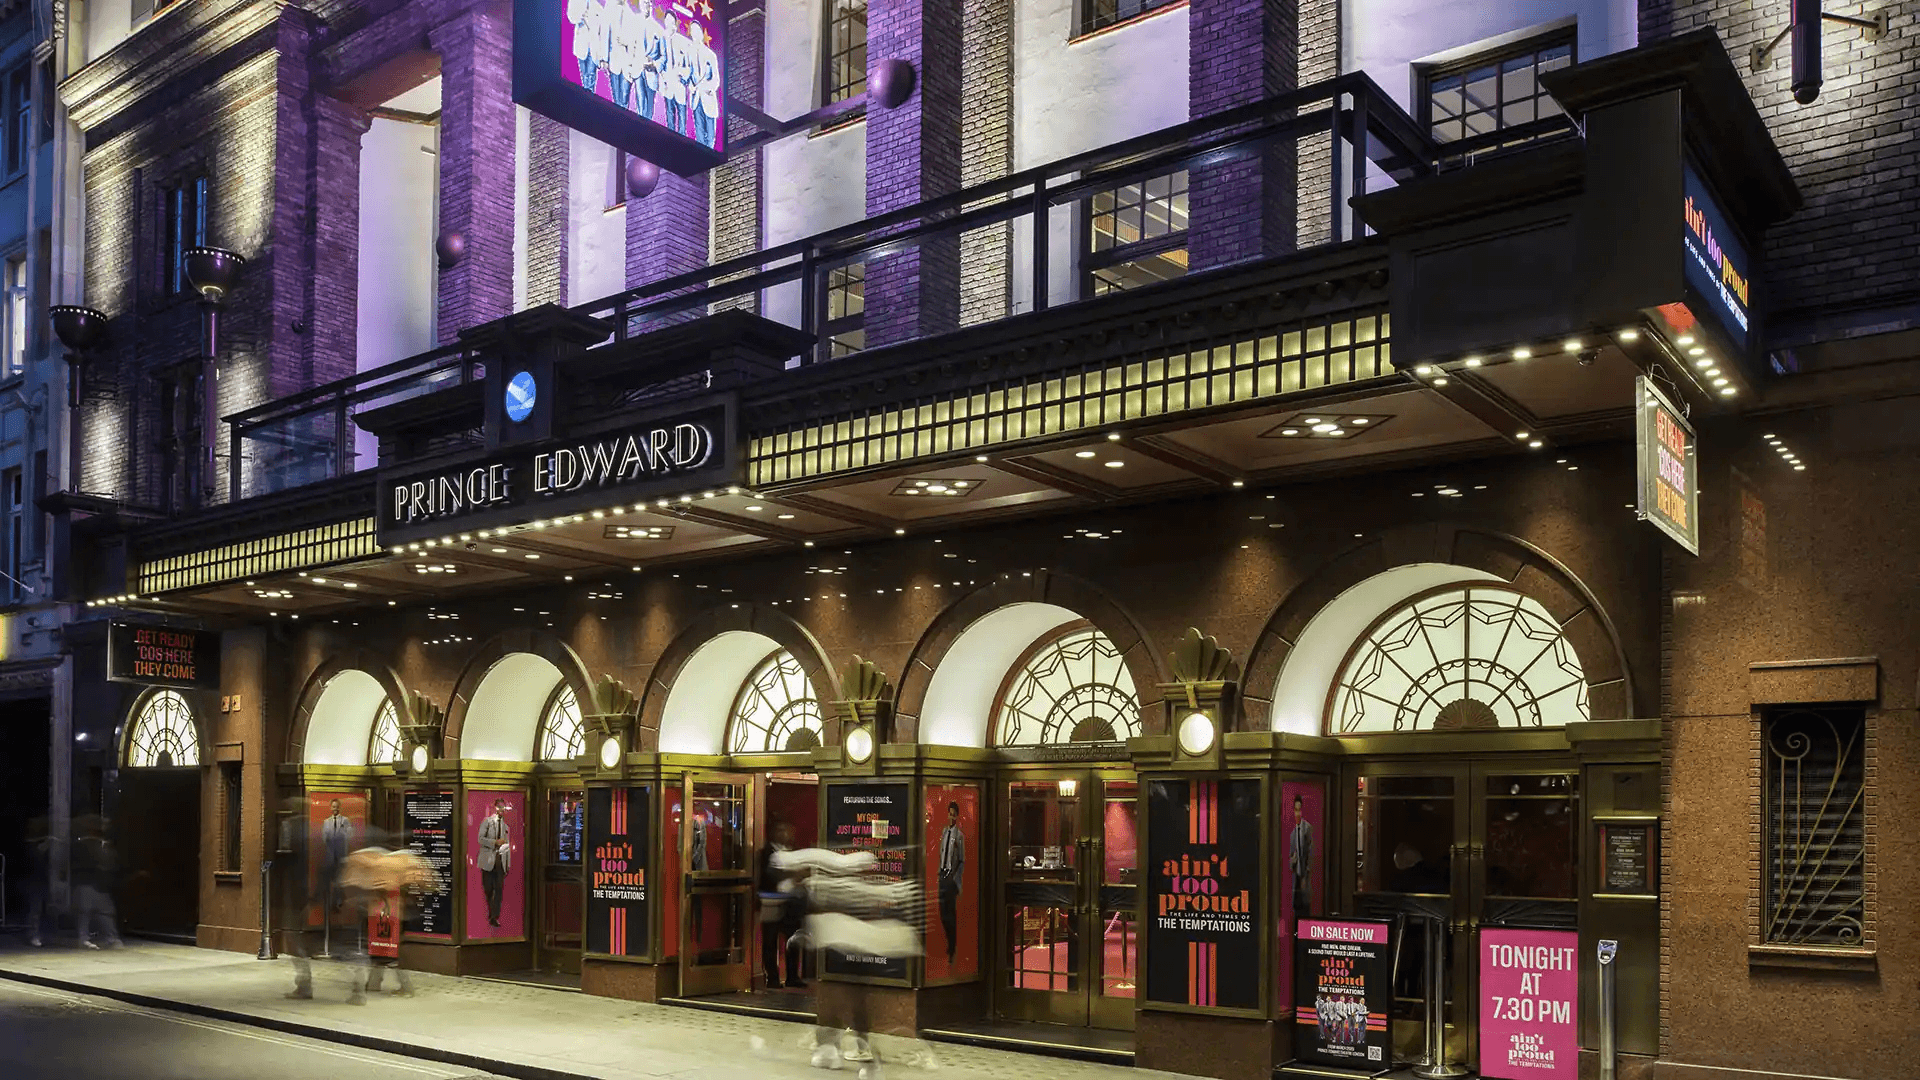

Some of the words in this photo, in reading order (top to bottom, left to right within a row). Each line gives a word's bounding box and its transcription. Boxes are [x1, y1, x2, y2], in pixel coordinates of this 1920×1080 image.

[1708, 223, 1722, 268] too
[1722, 253, 1748, 307] proud
[395, 463, 505, 521] PRINCE
[534, 423, 703, 492] EDWARD
[136, 630, 156, 644] GET
[160, 632, 194, 648] READY
[166, 648, 193, 664] HERE
[134, 660, 161, 676] THEY
[164, 664, 195, 680] COME
[844, 796, 866, 804] FEATURING
[866, 796, 874, 804] THE
[857, 813, 866, 822] MY
[837, 825, 851, 834] JUST
[852, 825, 861, 835] MY
[853, 838, 862, 847] GET
[596, 842, 632, 859] ain't
[887, 850, 906, 860] STONE
[601, 856, 627, 872] too
[1163, 854, 1229, 877] ain't
[593, 868, 644, 888] proud
[1172, 873, 1218, 895] too
[593, 890, 604, 898] THE
[605, 890, 644, 900] TEMPTATIONS
[1158, 890, 1250, 916] proud
[1158, 918, 1176, 928] THE
[1180, 919, 1250, 932] TEMPTATIONS
[1310, 926, 1324, 938] ON
[1326, 926, 1348, 940] SALE
[1350, 928, 1374, 941] NOW
[1320, 956, 1354, 969] ain't
[1489, 944, 1574, 971] TONIGHT
[1326, 966, 1349, 977] too
[1318, 975, 1364, 986] proud
[1520, 972, 1542, 996] AT
[1329, 987, 1365, 995] TEMPTATIONS
[1492, 996, 1534, 1022] 7.30
[1539, 1000, 1570, 1024] PM
[1510, 1033, 1544, 1044] ain't
[1515, 1042, 1538, 1051] too
[1508, 1050, 1554, 1060] proud
[1520, 1060, 1555, 1069] TEMPTATIONS
